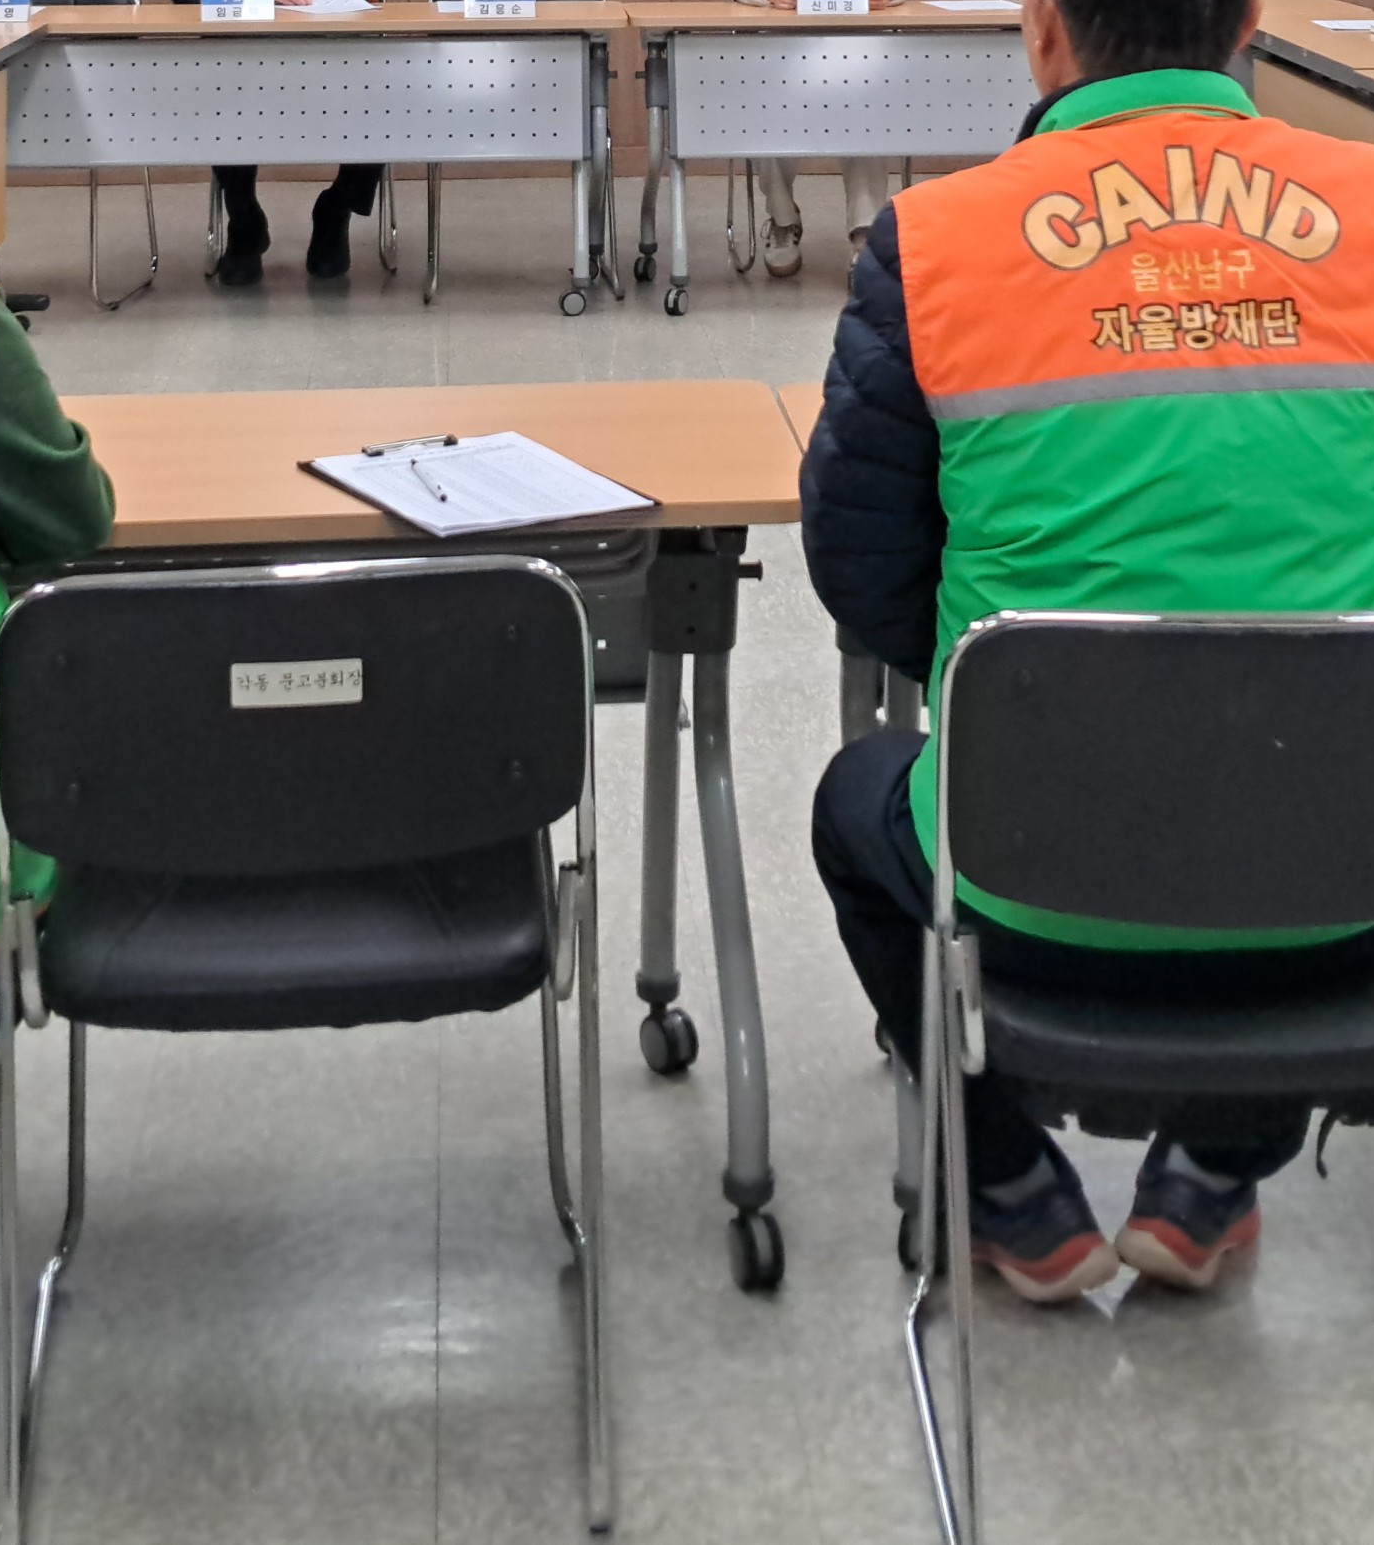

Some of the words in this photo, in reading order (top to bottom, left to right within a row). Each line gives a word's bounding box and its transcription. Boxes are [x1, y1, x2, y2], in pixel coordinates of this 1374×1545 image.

[216, 7, 242, 18] 임금
[811, 1, 853, 12] 신미경
[1022, 145, 1340, 271] CAIND
[1130, 248, 1257, 294] 울산남구
[1092, 298, 1300, 353] 자율방재단
